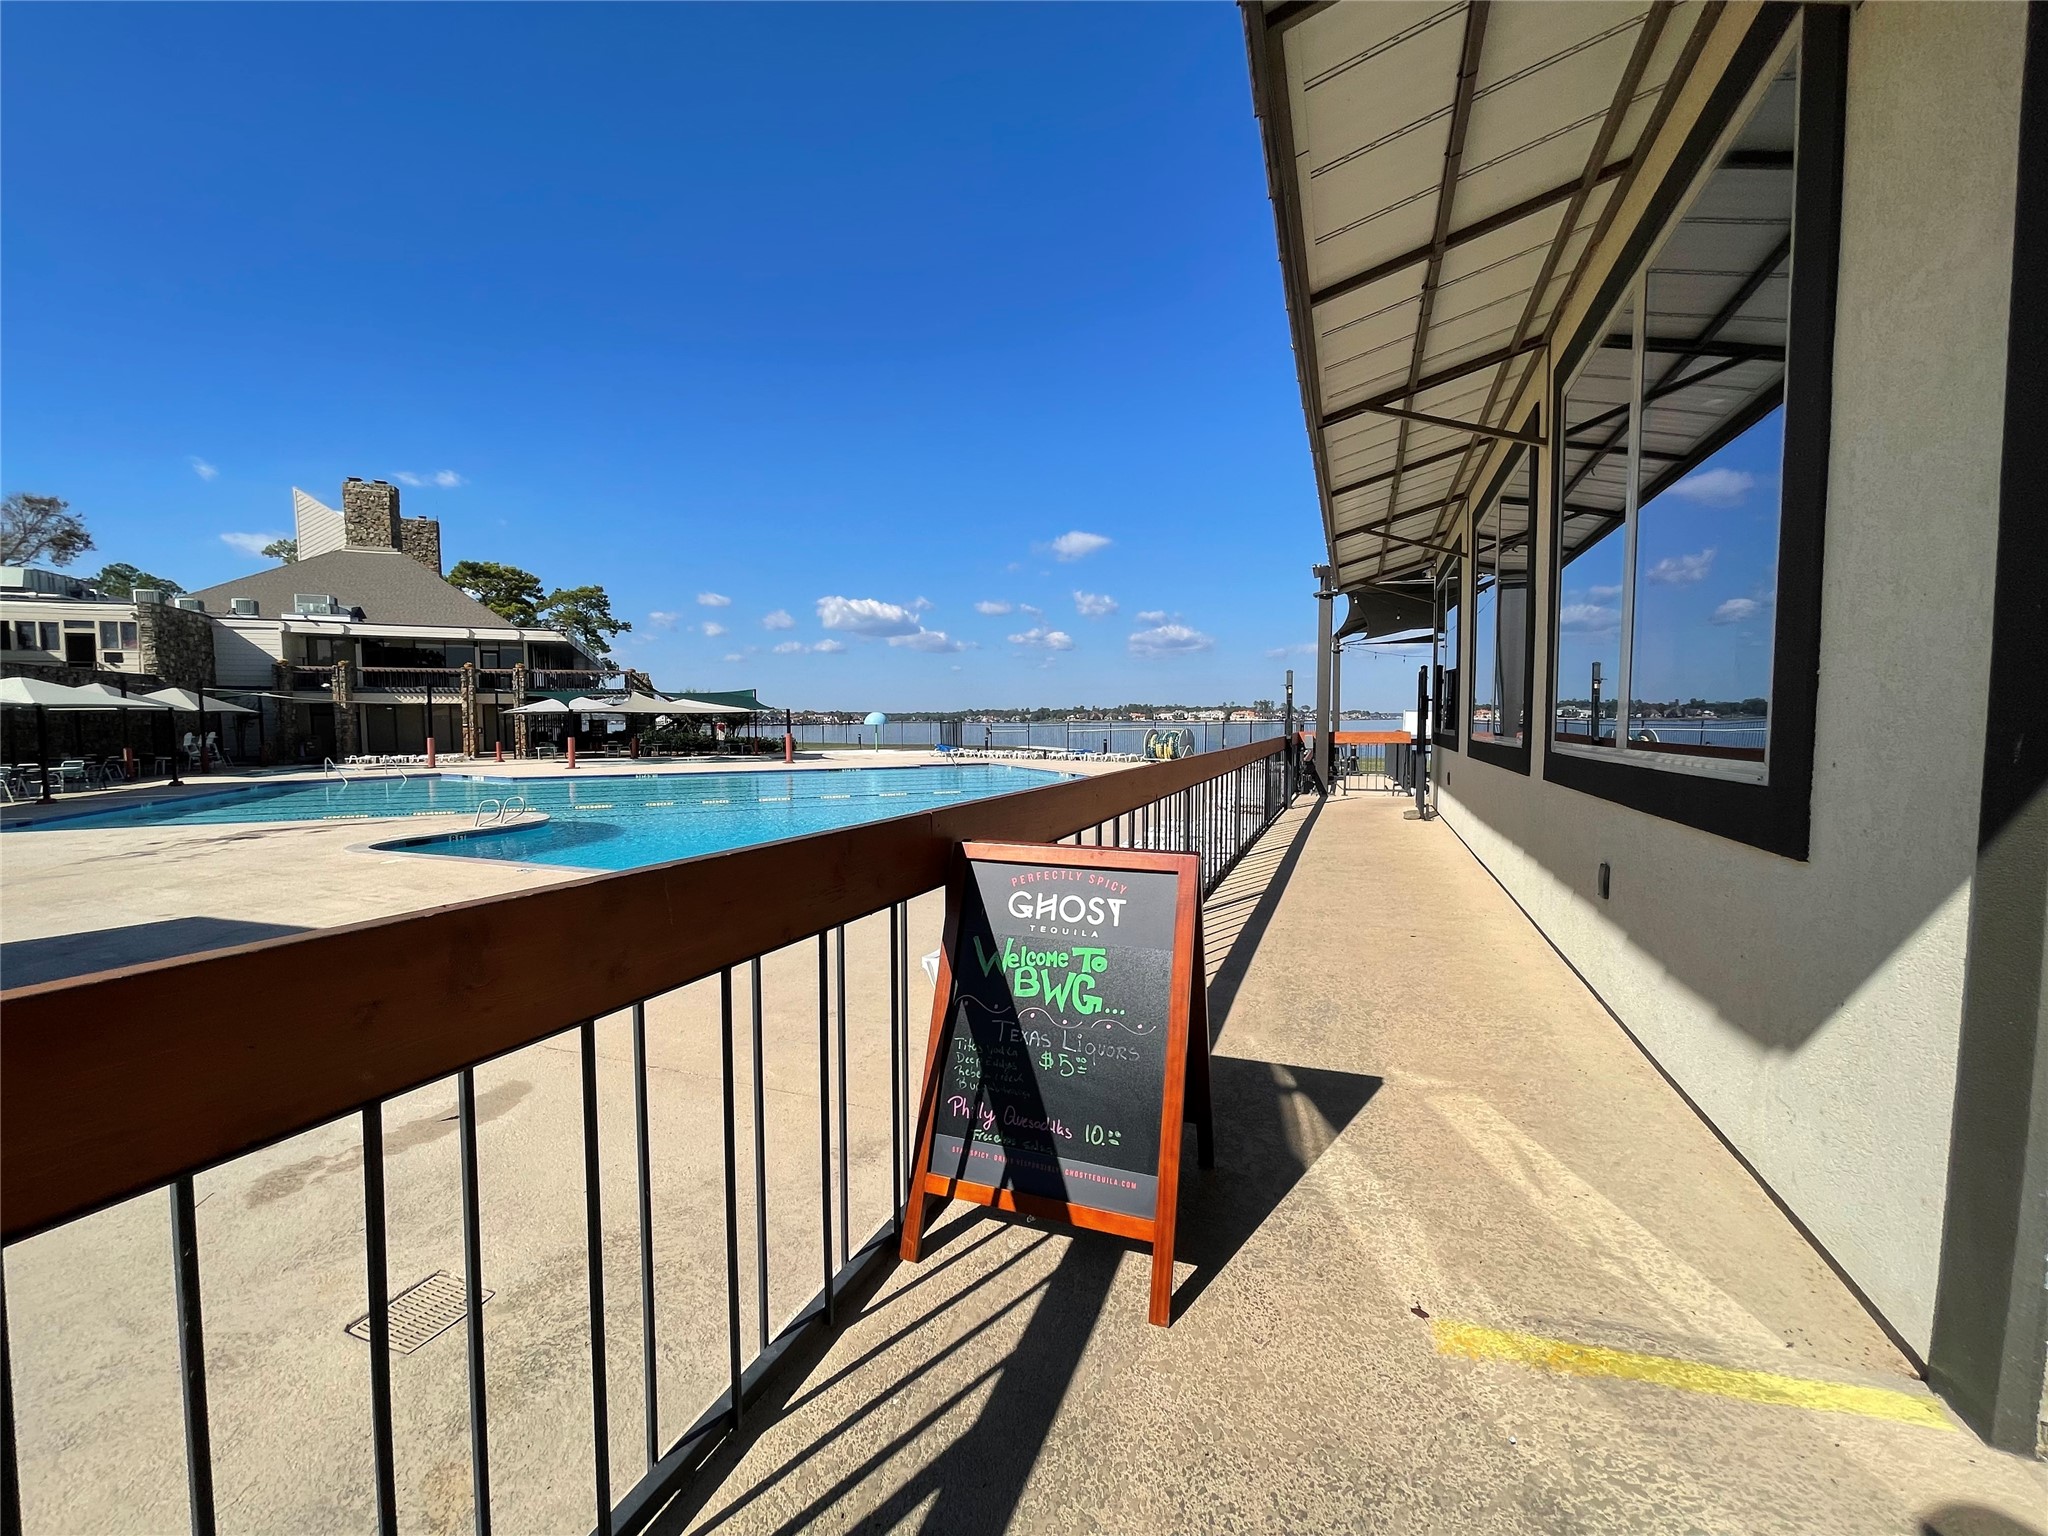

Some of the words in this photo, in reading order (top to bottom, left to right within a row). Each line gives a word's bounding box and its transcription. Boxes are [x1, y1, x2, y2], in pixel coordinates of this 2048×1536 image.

[1010, 870, 1083, 887] PERFECTLY
[1088, 874, 1128, 895] SPICY
[1008, 890, 1127, 927] GHOST
[1029, 924, 1099, 938] TEQUILA
[973, 937, 1069, 978] Welcome
[1071, 947, 1108, 974] To
[1064, 1168, 1137, 1190] GHOSTTEQUILA.COM
